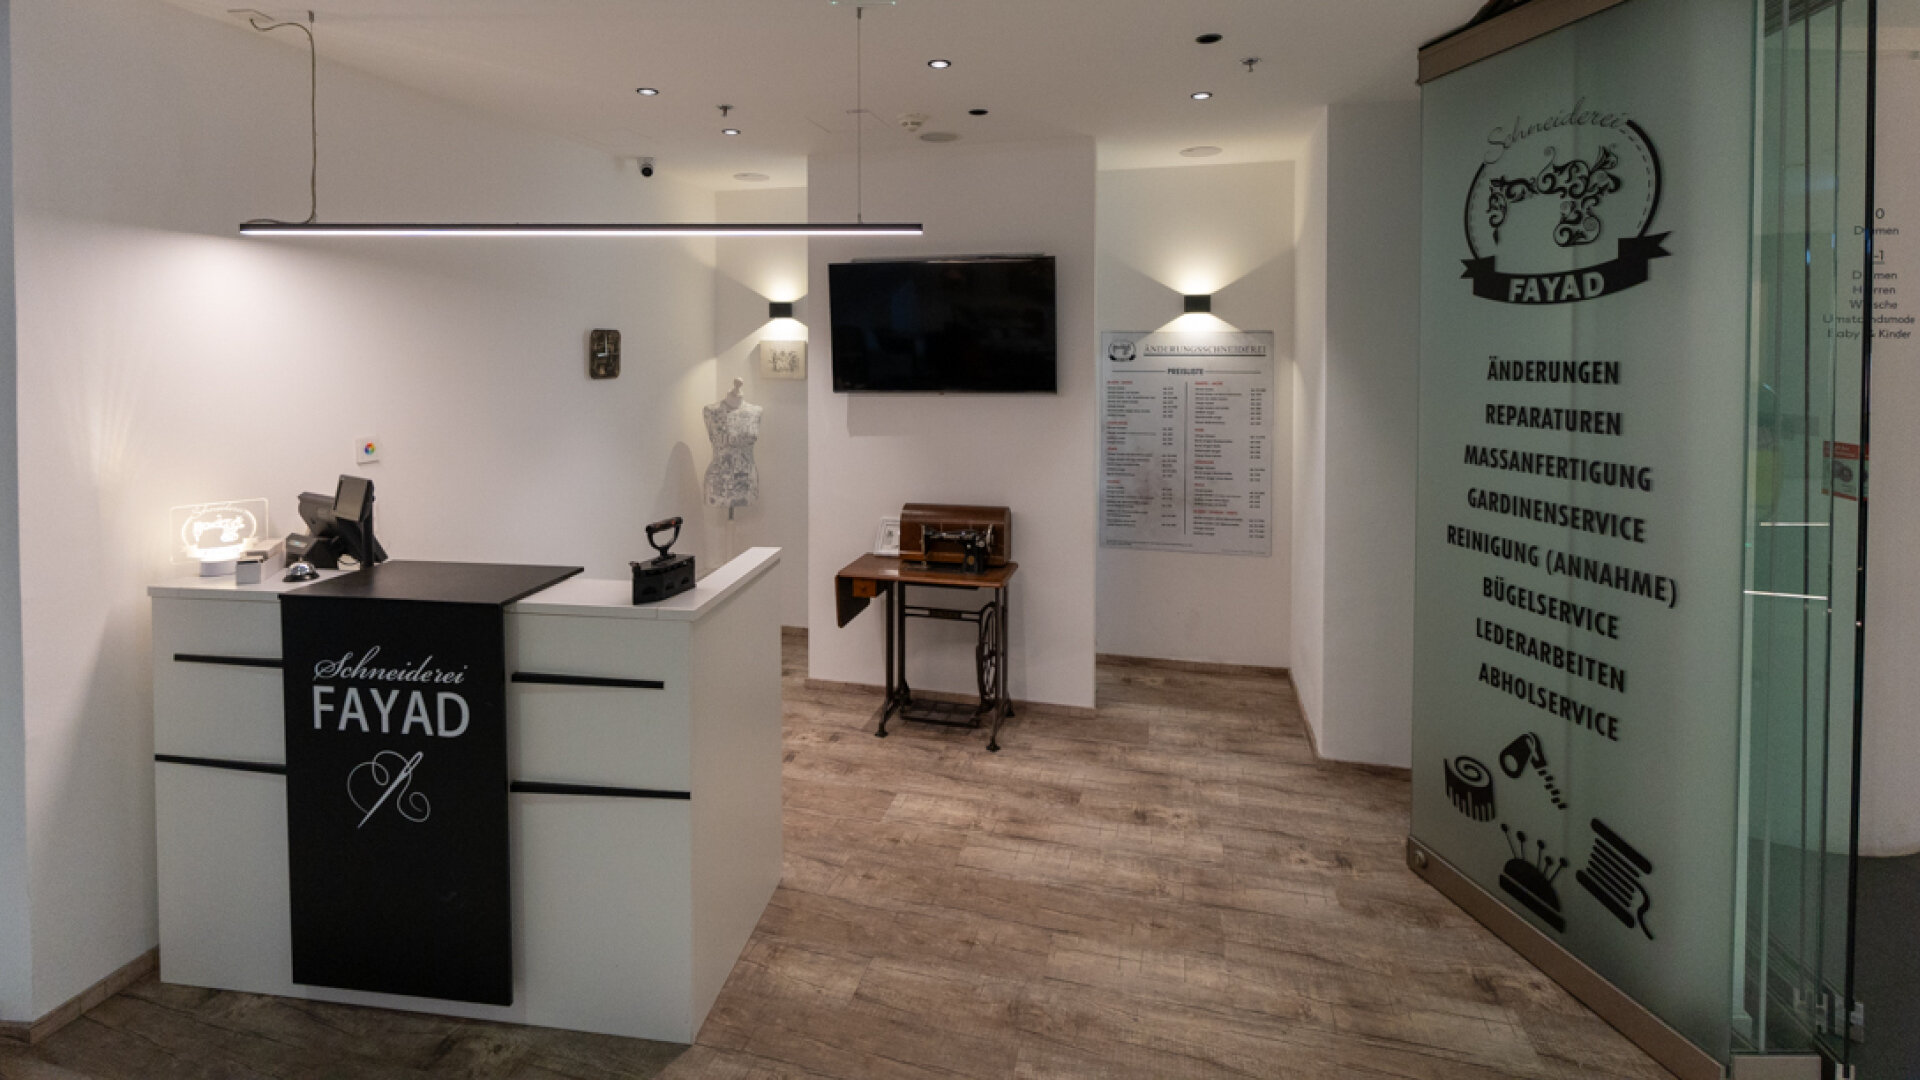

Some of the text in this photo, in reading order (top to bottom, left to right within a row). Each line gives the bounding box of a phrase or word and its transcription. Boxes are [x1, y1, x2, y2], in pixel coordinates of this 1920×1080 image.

[1484, 97, 1628, 164] Schneiderei
[1854, 225, 1899, 235] Dmen
[1508, 272, 1605, 302] FAYAD
[1852, 270, 1897, 280] Dmen
[1852, 285, 1896, 294] Hrren
[1849, 299, 1897, 309] Wsche
[1879, 329, 1912, 339] Kinder
[1487, 356, 1621, 384] ÄNDERUNGEN
[1486, 404, 1622, 436] REPARATUREN
[1464, 444, 1653, 492] MASSANFERTIGUNG
[1467, 488, 1646, 543] GARDINENSERVICE
[1447, 525, 1677, 609] REINIGUNG (ANNAHME)
[1483, 576, 1619, 640] BÜGELSERVICE
[312, 645, 468, 684] Schneiderei
[1476, 617, 1626, 693] LEDERARBEITEN
[312, 685, 471, 738] FAYAD
[1479, 662, 1620, 742] ABHOLSERVICE
